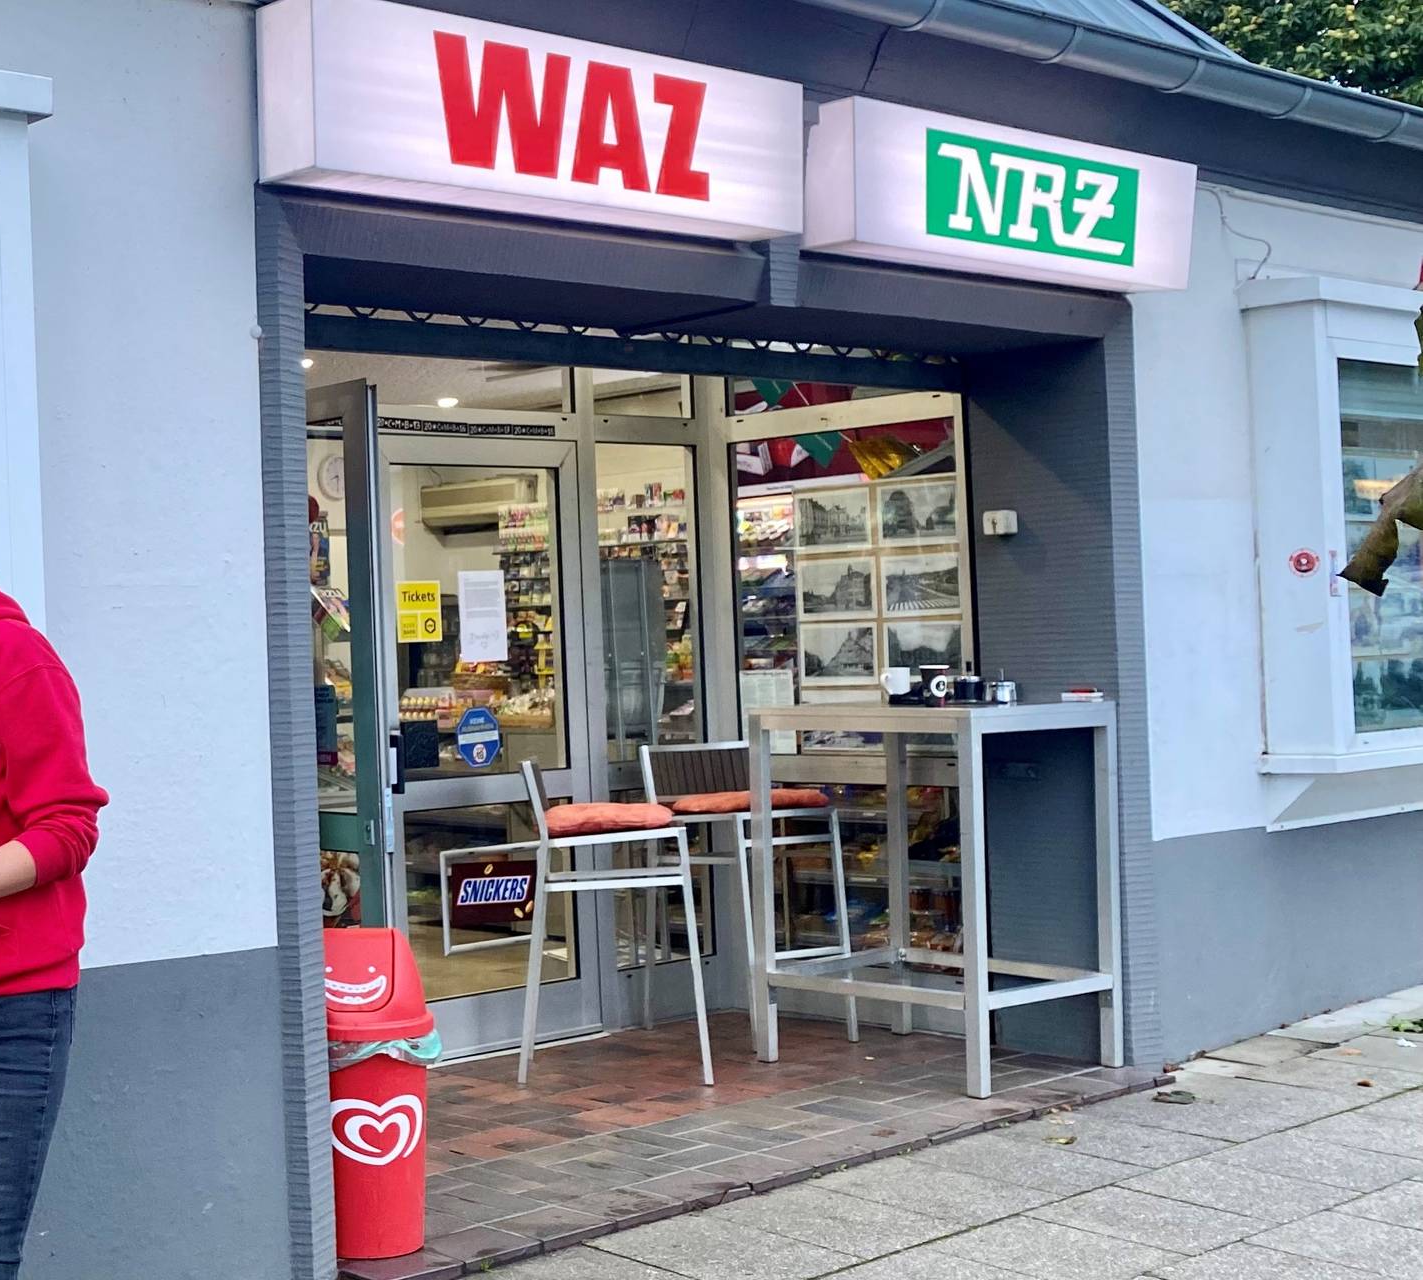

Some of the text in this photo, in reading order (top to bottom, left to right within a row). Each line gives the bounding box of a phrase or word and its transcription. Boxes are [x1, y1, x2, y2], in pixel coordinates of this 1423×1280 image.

[433, 30, 710, 201] WAZ
[937, 142, 1126, 256] NRZ
[401, 590, 436, 603] Tickets
[460, 877, 528, 904] SNICKERS
